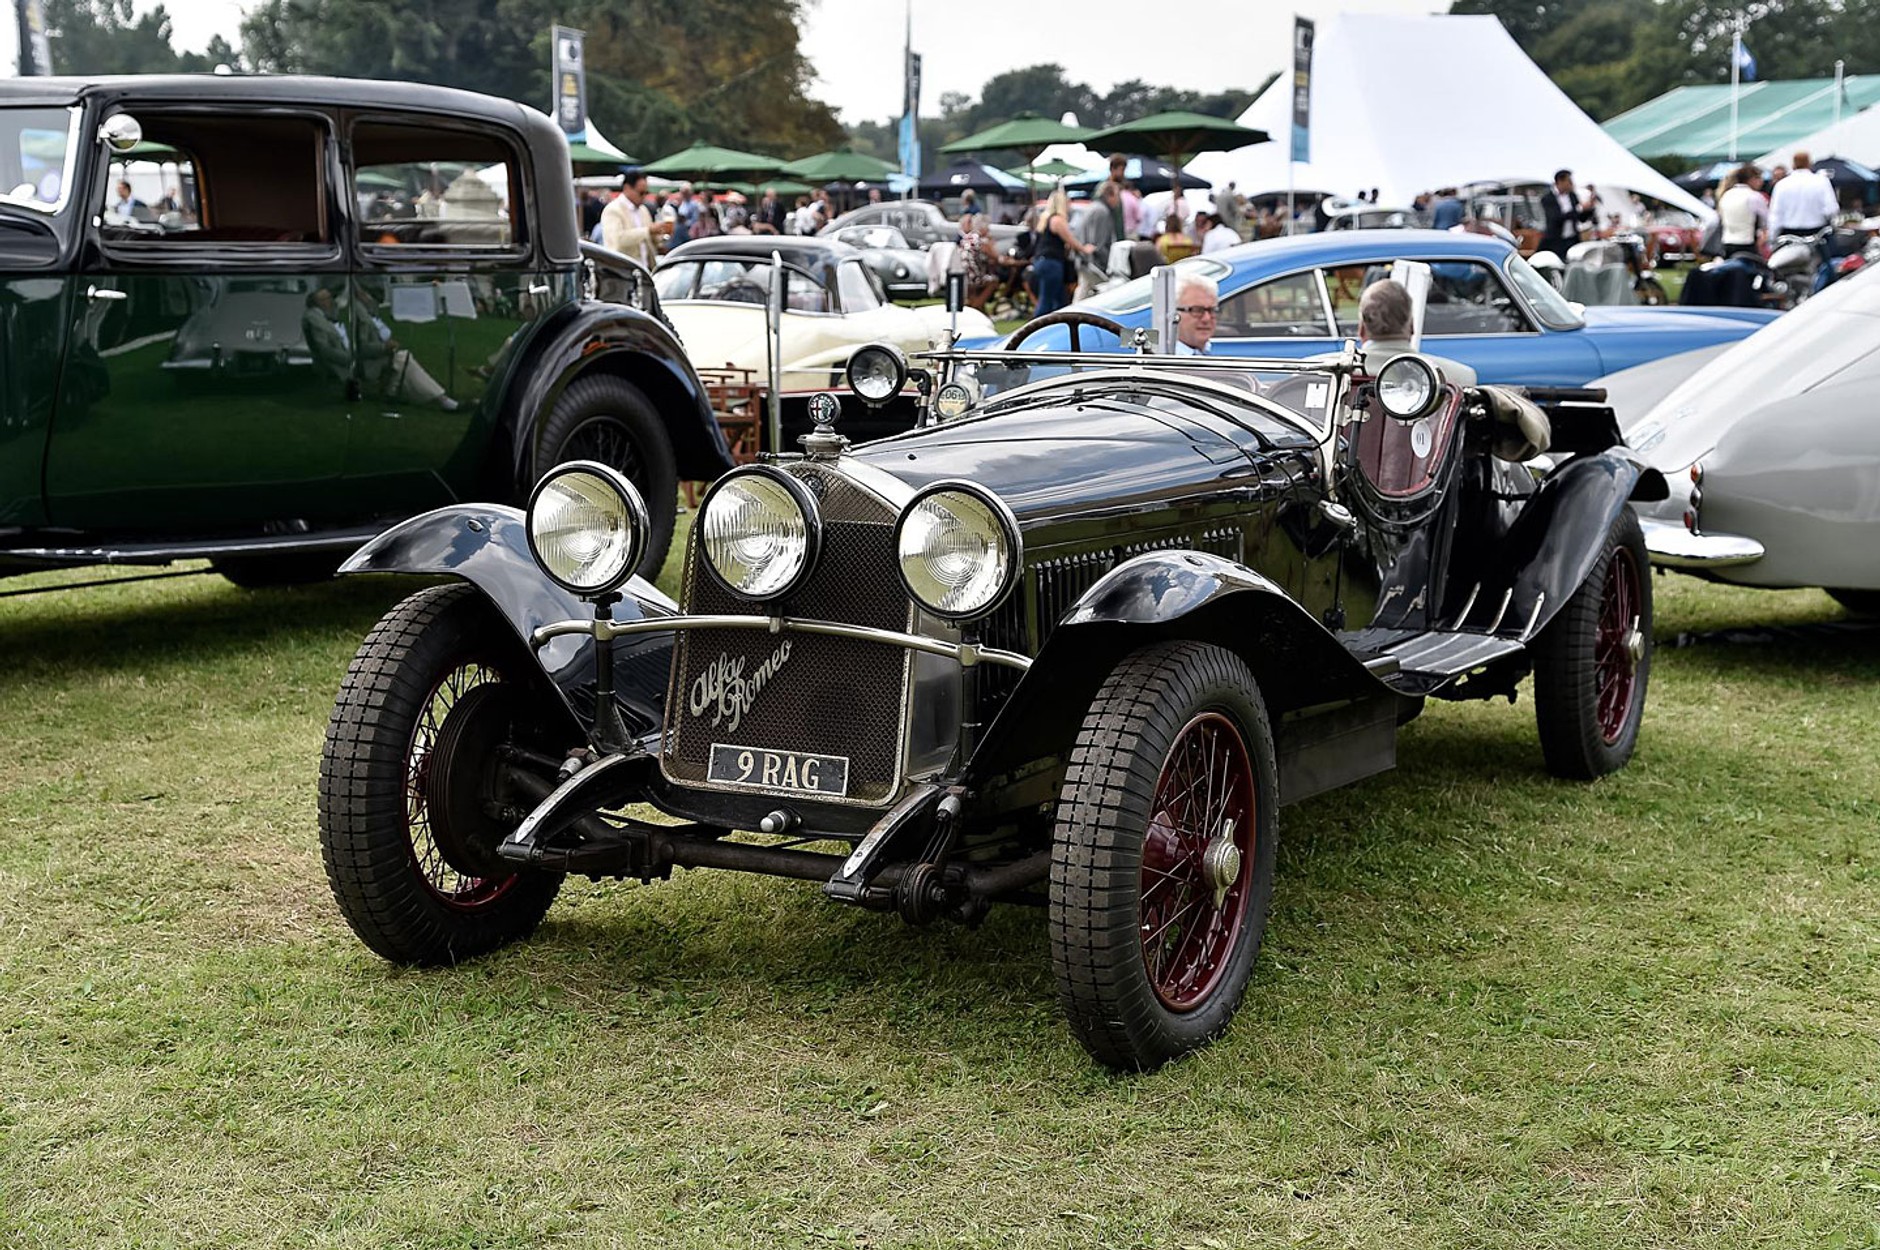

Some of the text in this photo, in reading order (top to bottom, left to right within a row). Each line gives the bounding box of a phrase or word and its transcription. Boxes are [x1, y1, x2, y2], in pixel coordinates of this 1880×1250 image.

[690, 652, 746, 728] Alfa
[722, 640, 792, 733] Romeo
[737, 752, 820, 791] 9 RAG
